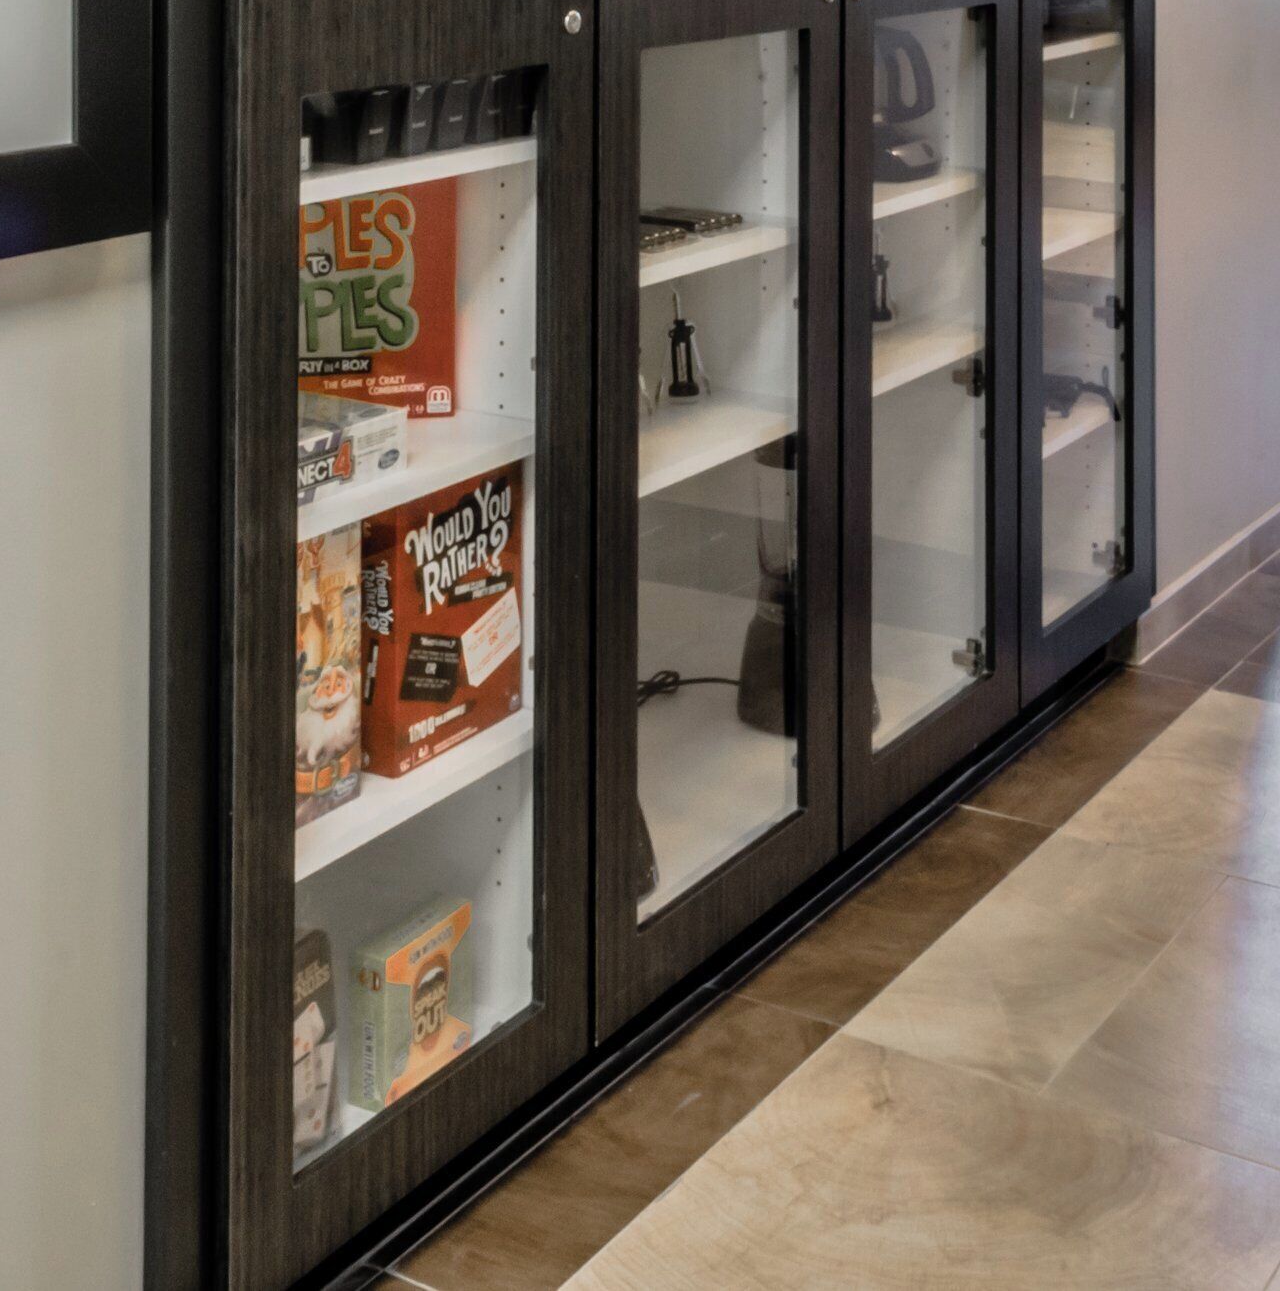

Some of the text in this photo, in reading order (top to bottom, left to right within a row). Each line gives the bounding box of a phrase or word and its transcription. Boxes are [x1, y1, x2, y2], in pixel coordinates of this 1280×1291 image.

[341, 360, 369, 371] BOX
[404, 481, 511, 567] WOULD YOU
[375, 560, 394, 636] WOULD YOU
[423, 520, 509, 616] RATHER?
